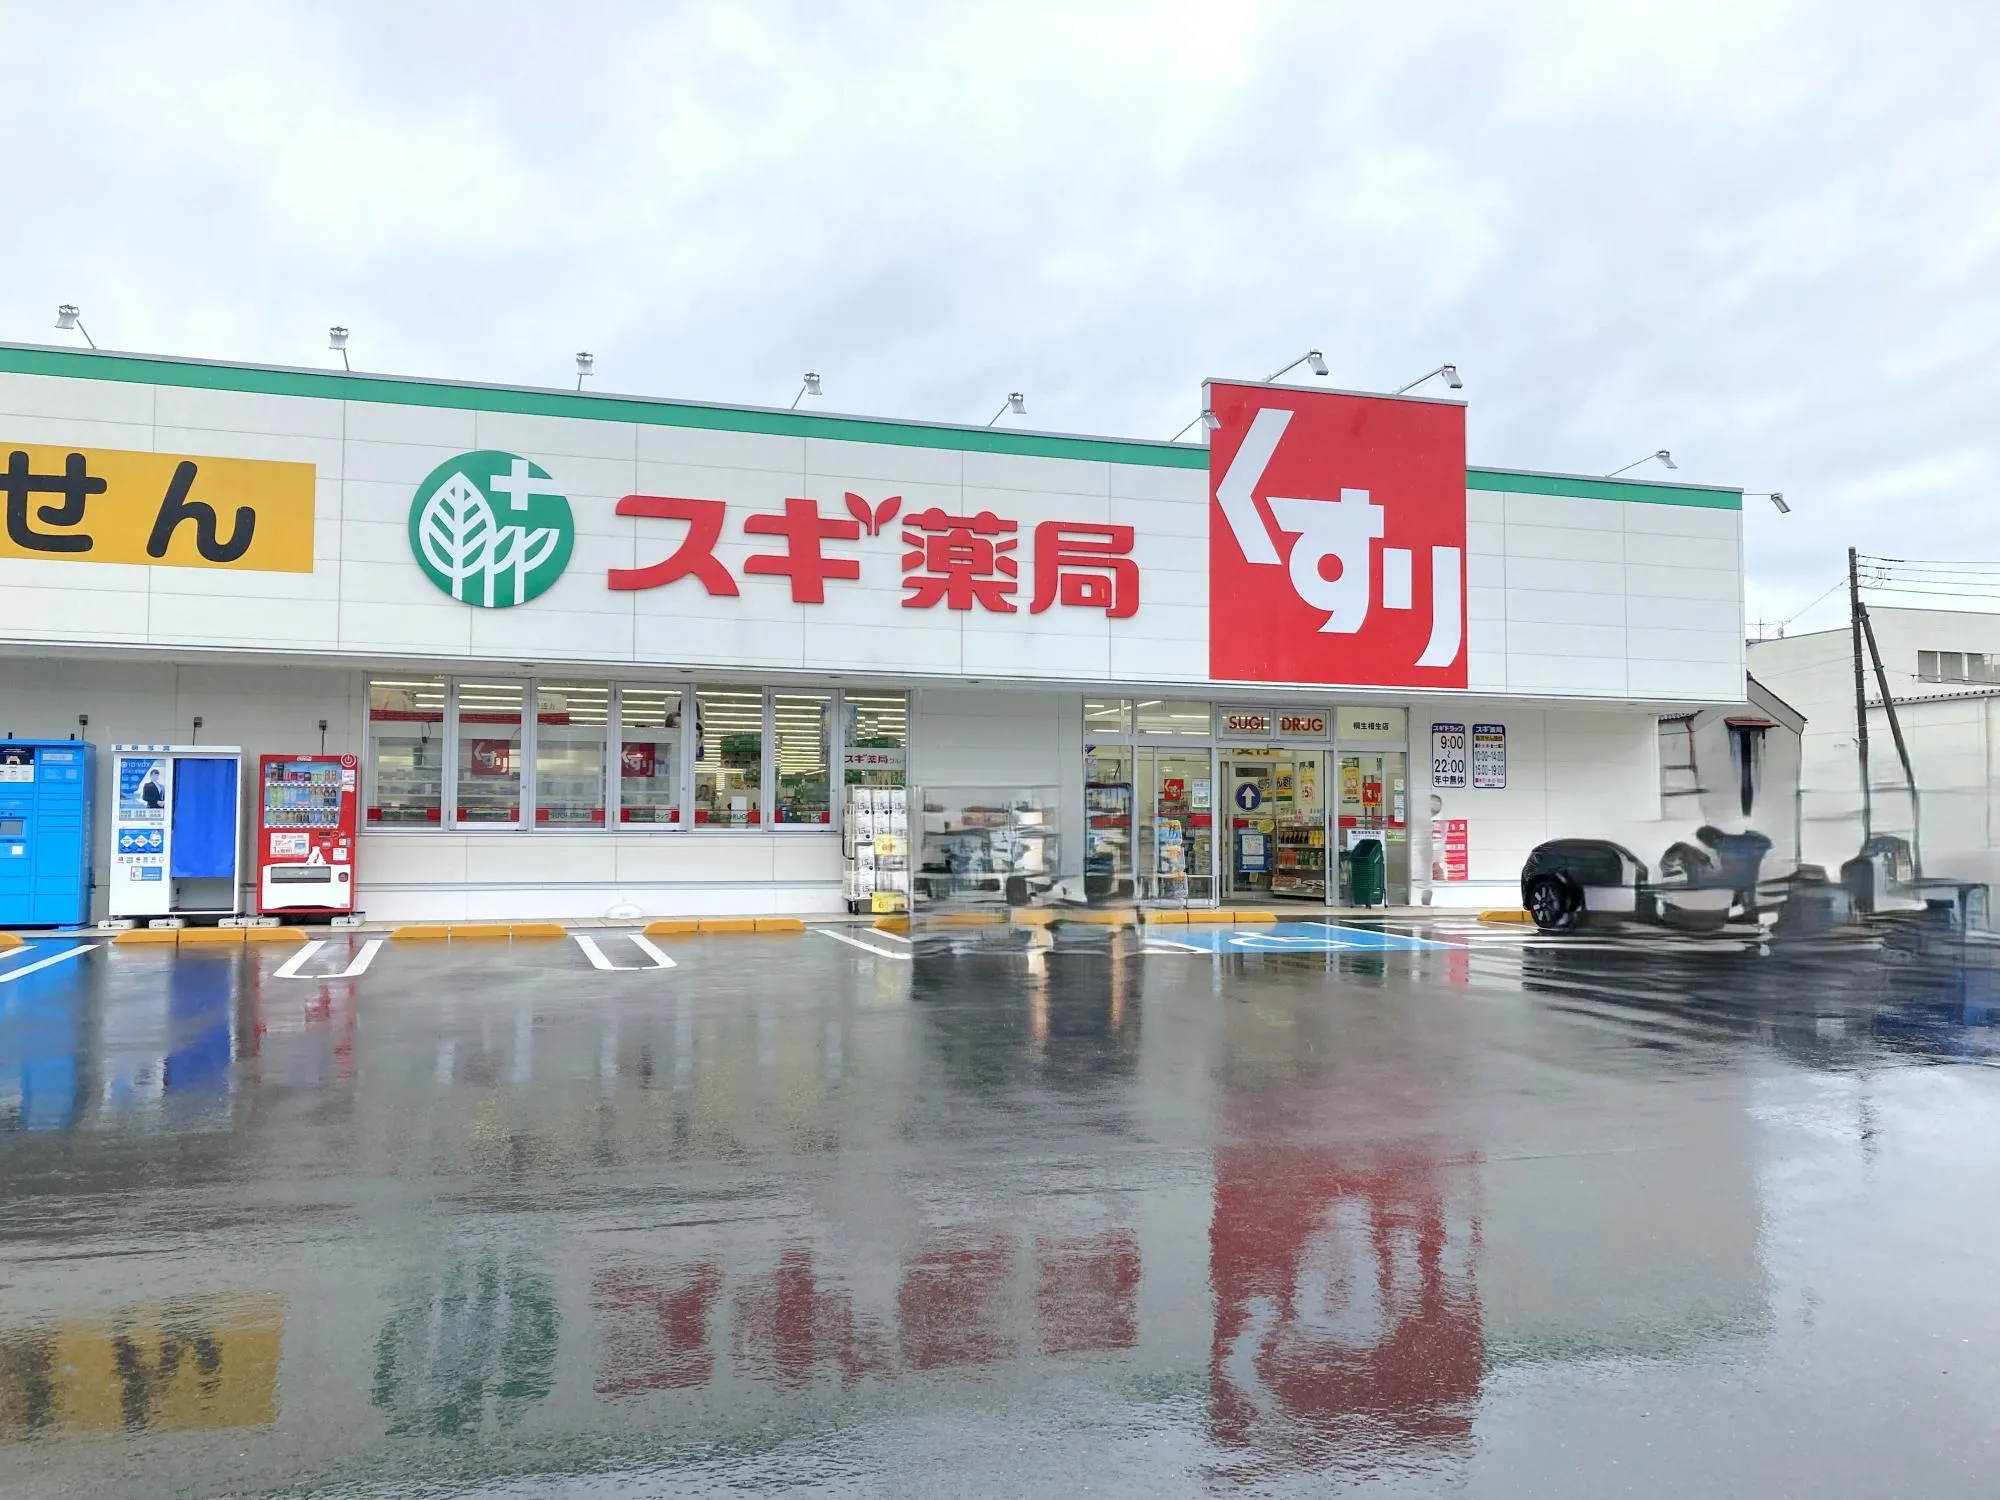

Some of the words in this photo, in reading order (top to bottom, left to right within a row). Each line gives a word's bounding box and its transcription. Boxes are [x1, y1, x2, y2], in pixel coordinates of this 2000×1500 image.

[0, 451, 256, 562] せん
[1216, 408, 1462, 668] くすり
[608, 492, 1140, 618] スギ薬局
[1229, 716, 1265, 730] SUGI
[1281, 717, 1324, 732] DRUG
[1441, 736, 1464, 749] 9:00
[1435, 759, 1464, 773] 22:00
[1435, 775, 1464, 785] 年中無休
